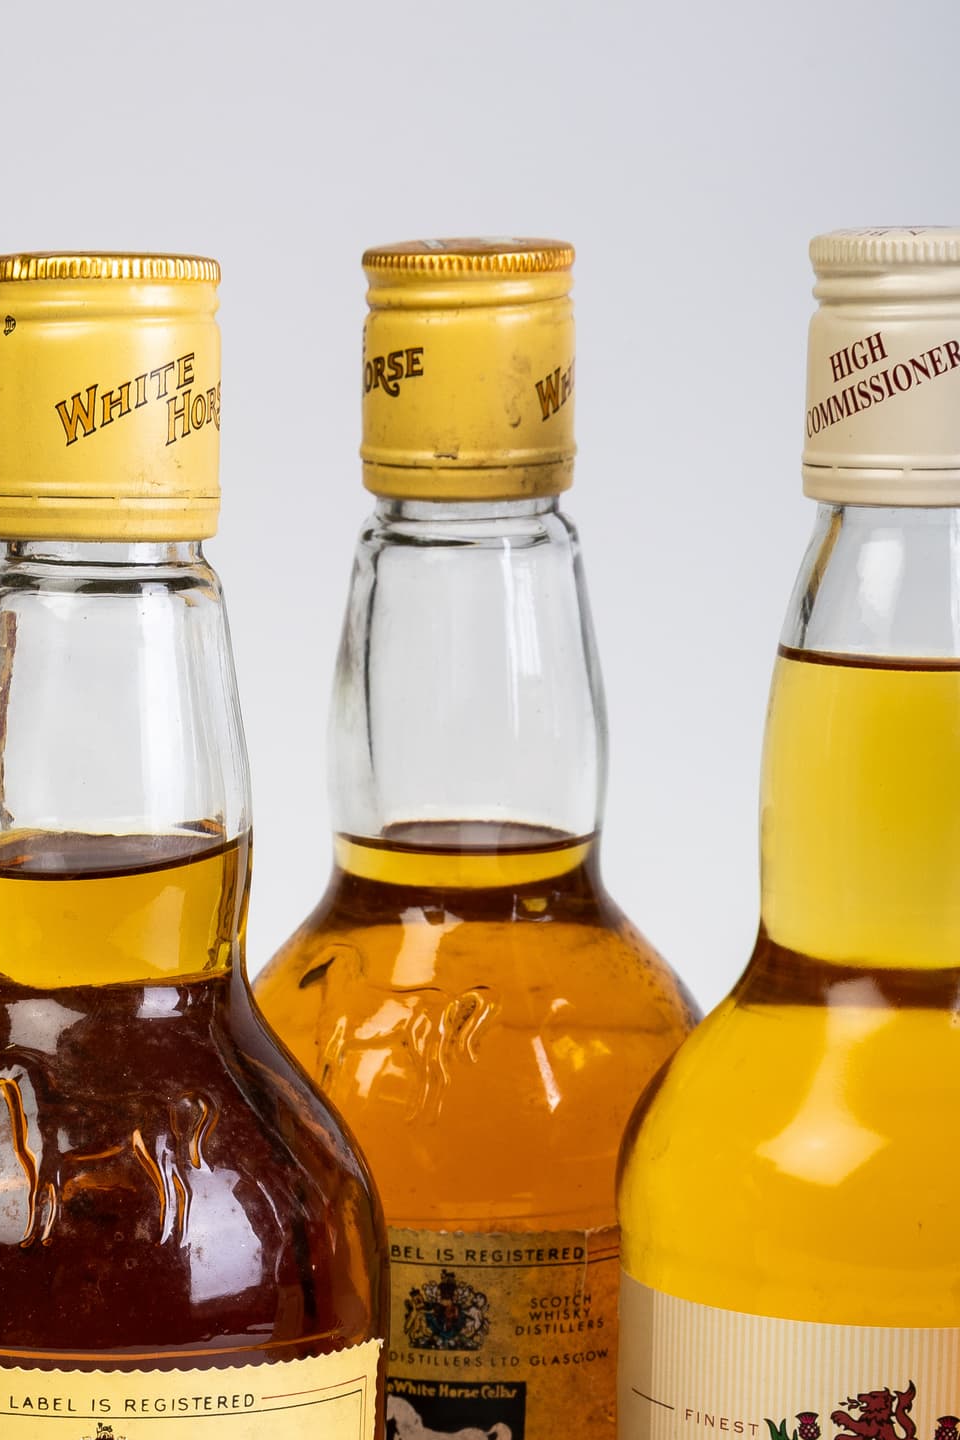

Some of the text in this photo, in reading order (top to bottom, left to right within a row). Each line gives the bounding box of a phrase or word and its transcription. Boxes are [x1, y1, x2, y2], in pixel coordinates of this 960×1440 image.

[828, 331, 889, 384] HIGH
[362, 345, 424, 398] ORSE
[806, 338, 960, 439] COMMISSIONER
[54, 352, 196, 447] WHITE
[436, 1248, 455, 1261] IS
[465, 1246, 585, 1262] REGISTERED
[530, 1293, 592, 1310] SCOTCH
[528, 1307, 591, 1321] WHISKY
[514, 1317, 604, 1336] DISTILLERS
[390, 1351, 483, 1368] DISTILLERS
[528, 1347, 609, 1367] GLASGOW
[394, 1379, 437, 1396] White
[439, 1383, 480, 1399] Horse
[9, 1395, 78, 1412] LABEL
[91, 1398, 112, 1412] IS
[124, 1393, 255, 1413] REGISTERED
[684, 1408, 760, 1437] FINEST
